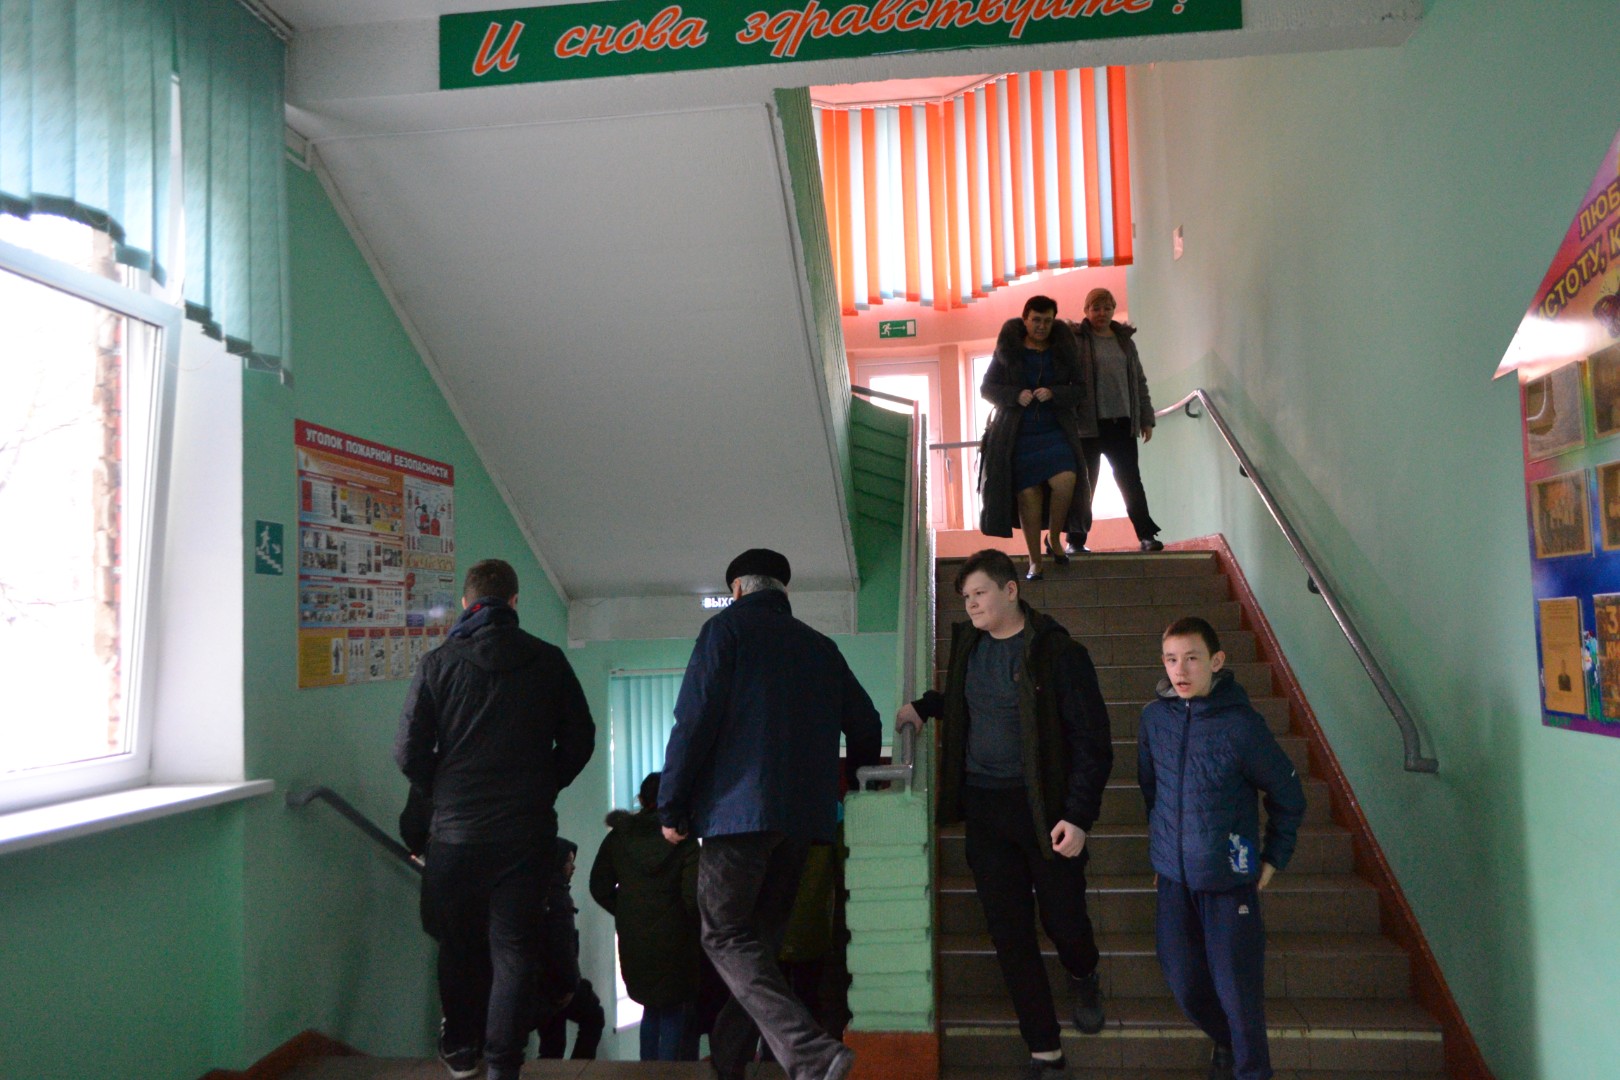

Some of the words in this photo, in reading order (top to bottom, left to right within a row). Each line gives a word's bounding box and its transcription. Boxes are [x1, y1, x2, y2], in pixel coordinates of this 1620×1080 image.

[472, 20, 526, 77] И
[554, 4, 710, 59] снова
[305, 428, 343, 450] УГОЛОК
[346, 440, 392, 464] ПОЖАРНОЙ
[394, 454, 449, 479] БЕЗОПАСНОСТИ
